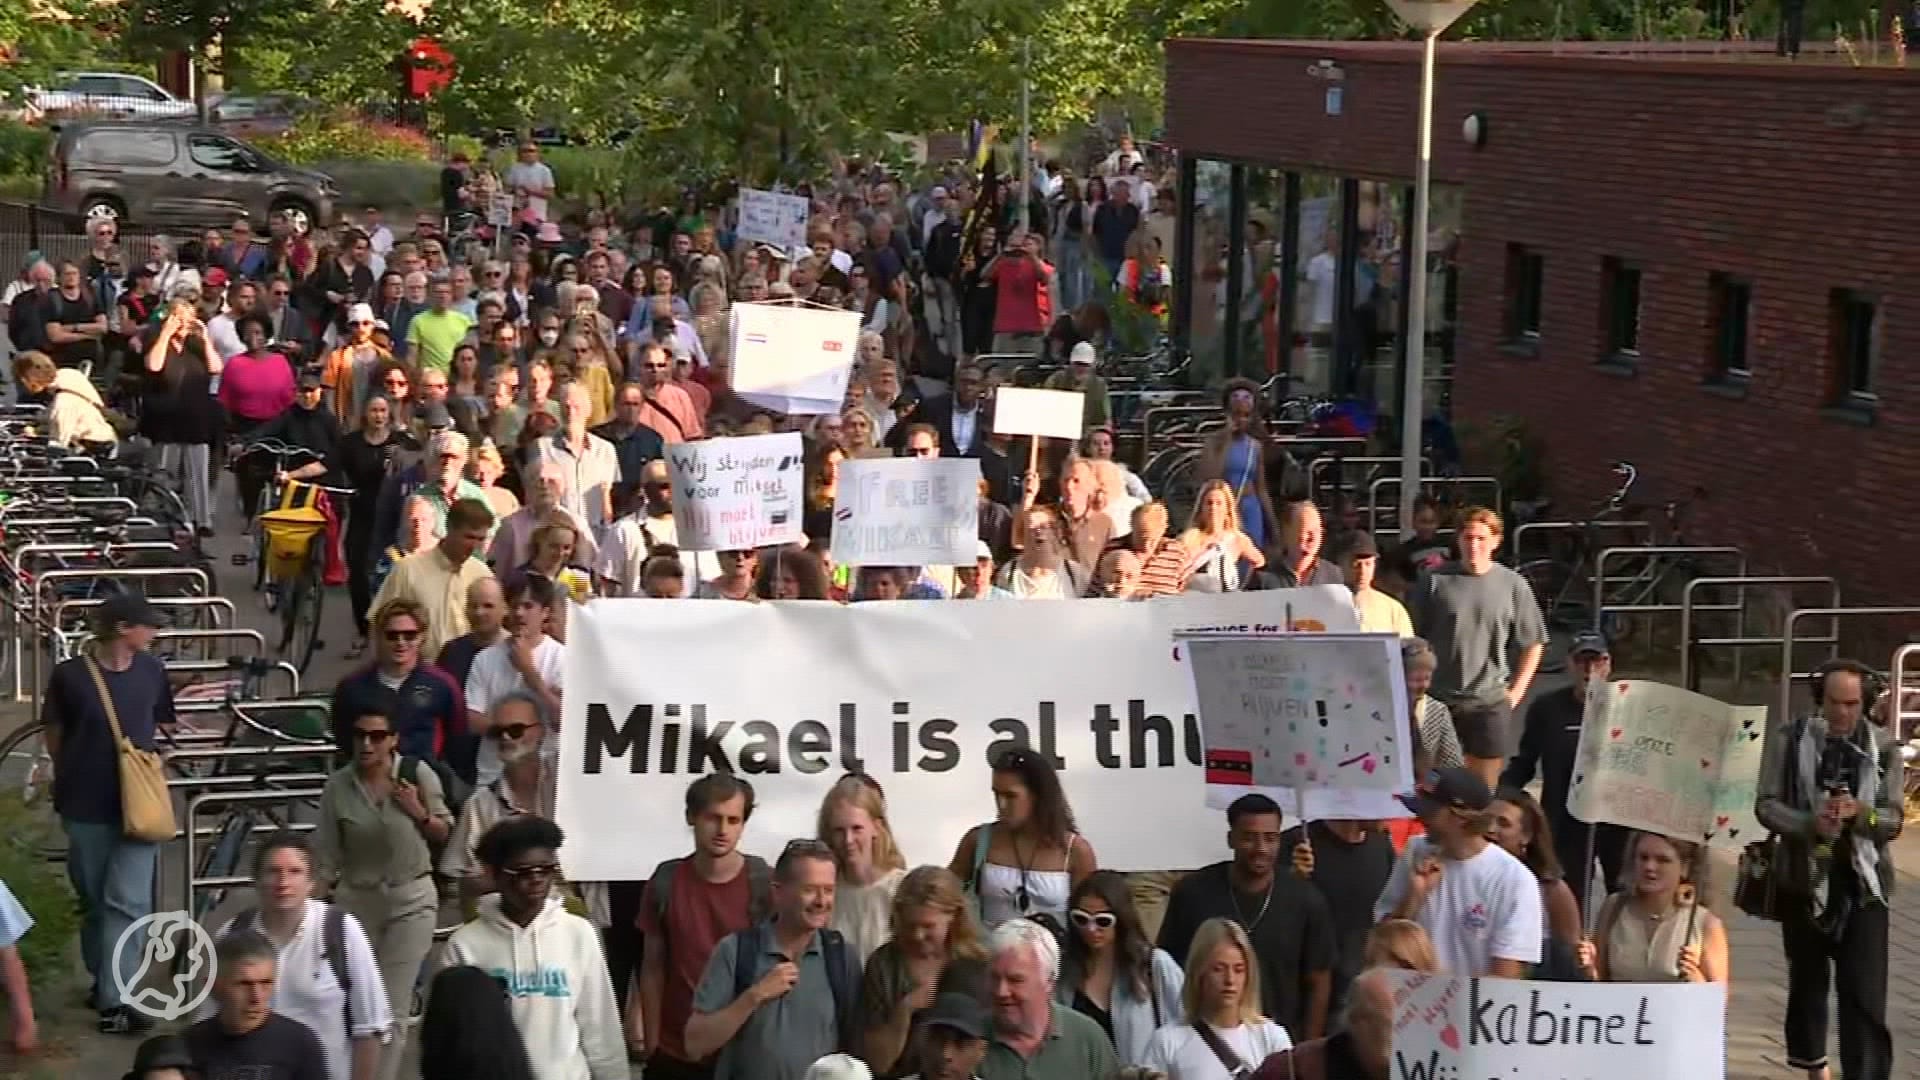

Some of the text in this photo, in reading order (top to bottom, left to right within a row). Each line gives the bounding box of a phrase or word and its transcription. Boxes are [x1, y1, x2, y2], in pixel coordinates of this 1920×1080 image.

[672, 449, 707, 482] Wij
[684, 486, 720, 499] voor
[583, 702, 864, 774] Mikael
[892, 704, 960, 773] is
[988, 701, 1066, 772] al
[1468, 978, 1655, 1045] kabinet
